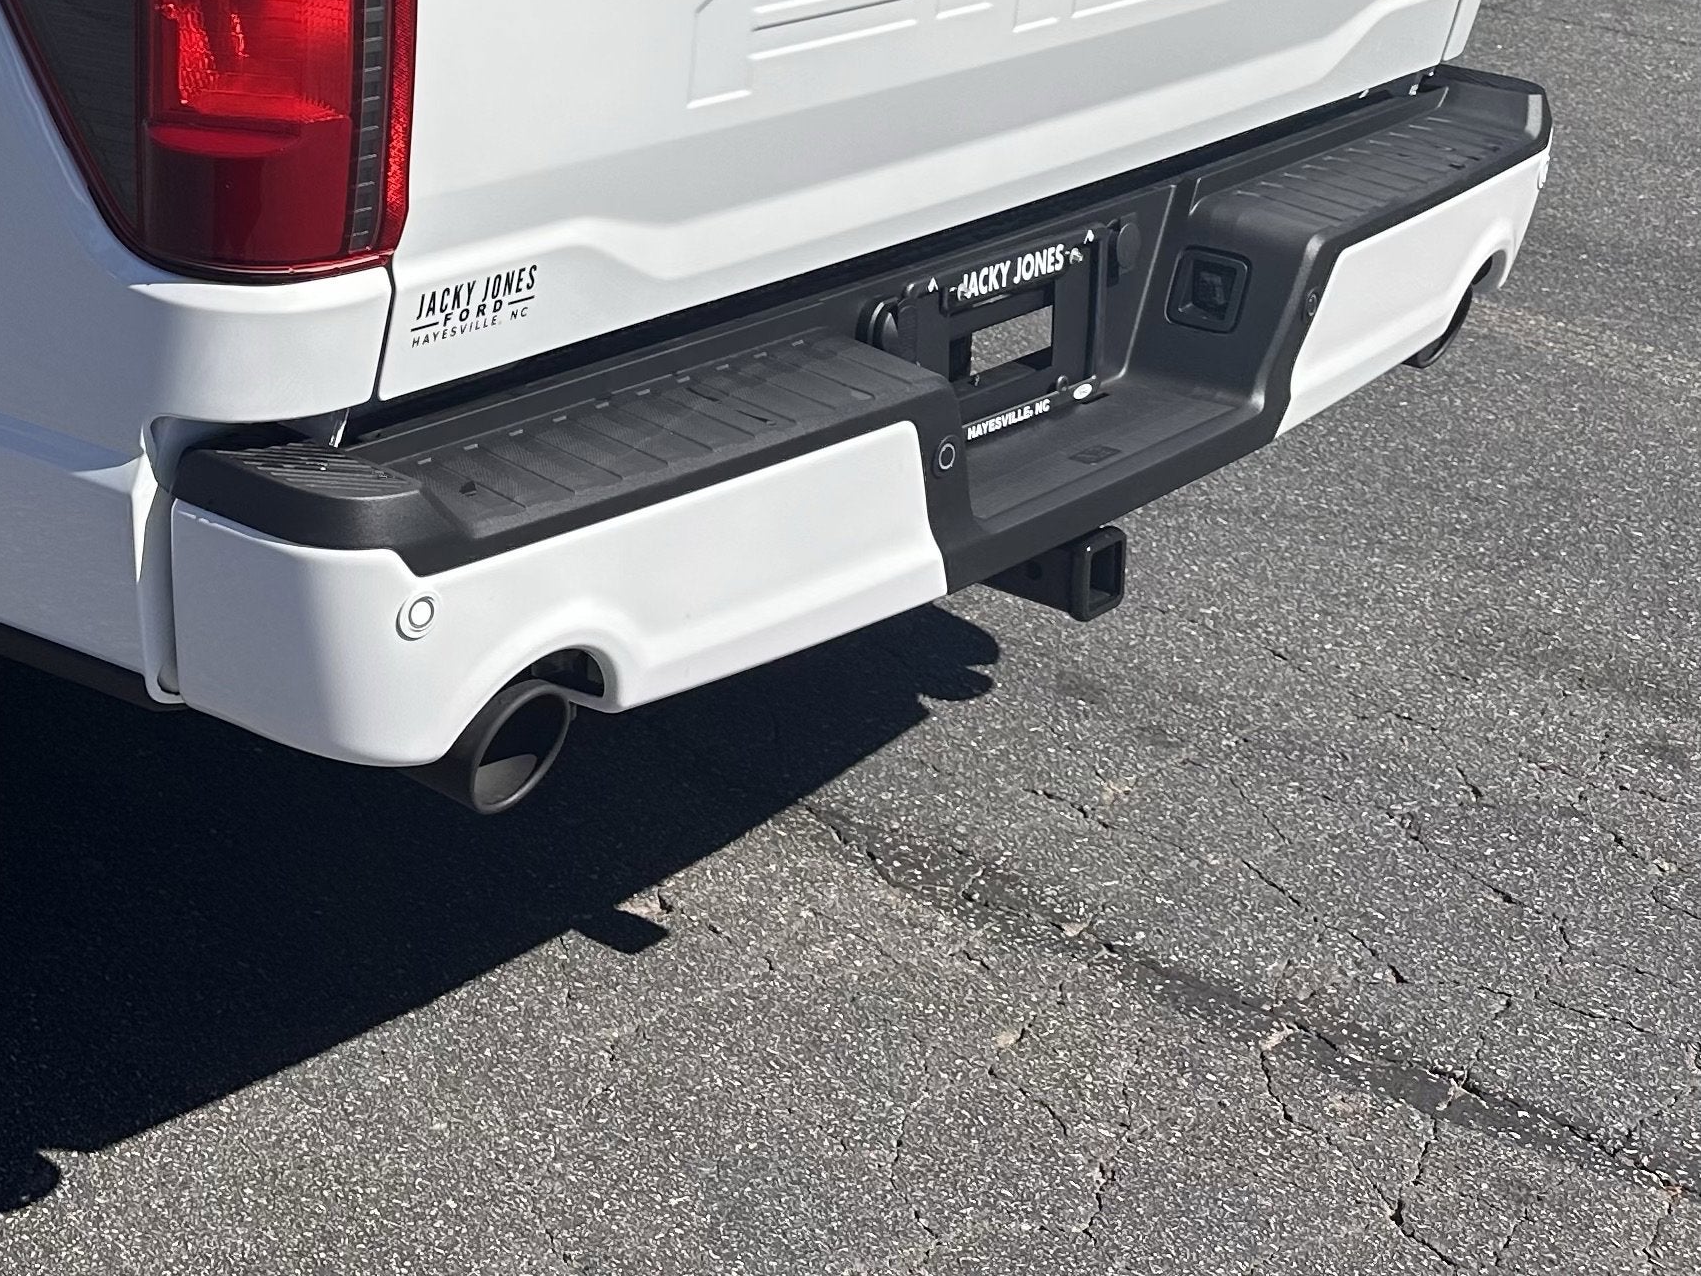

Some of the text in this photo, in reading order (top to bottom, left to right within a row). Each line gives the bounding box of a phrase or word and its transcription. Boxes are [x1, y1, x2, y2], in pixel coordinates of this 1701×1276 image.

[1013, 243, 1065, 283] JONES
[416, 264, 538, 321] JACKY JONES
[443, 299, 503, 327] FORD
[509, 306, 529, 321] NC
[1034, 399, 1050, 415] NC
